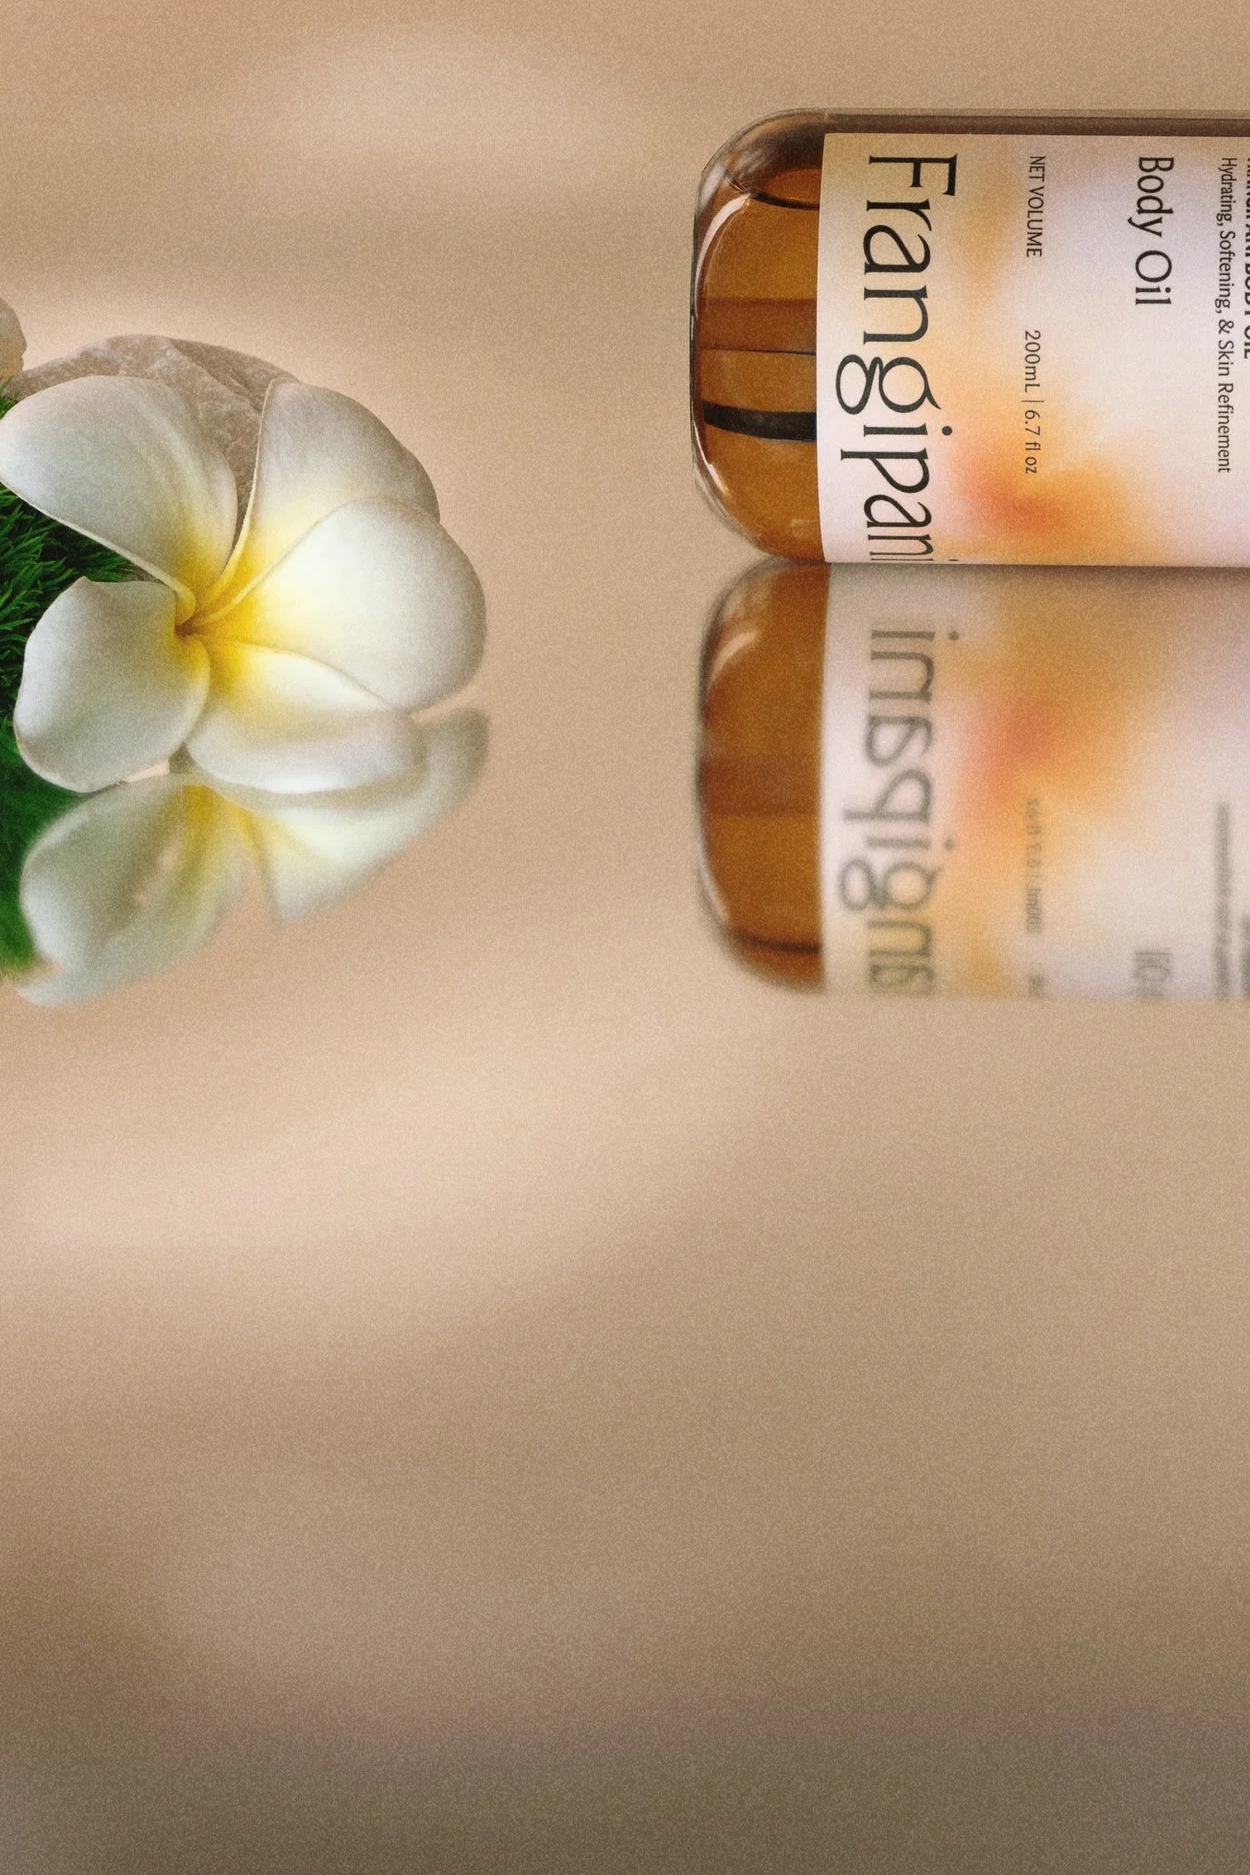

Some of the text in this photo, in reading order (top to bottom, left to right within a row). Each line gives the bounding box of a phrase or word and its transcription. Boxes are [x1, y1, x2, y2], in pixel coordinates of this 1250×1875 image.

[1026, 155, 1046, 258] NET VOLUME
[1127, 156, 1175, 305] Body Oil
[835, 153, 959, 561] Frangipani
[1214, 157, 1237, 474] Hydrating, Softening, & Skin Refinement
[1024, 329, 1042, 393] 200mL
[1024, 409, 1041, 437] 6.7
[1024, 440, 1041, 451] fl
[1024, 455, 1037, 475] oz
